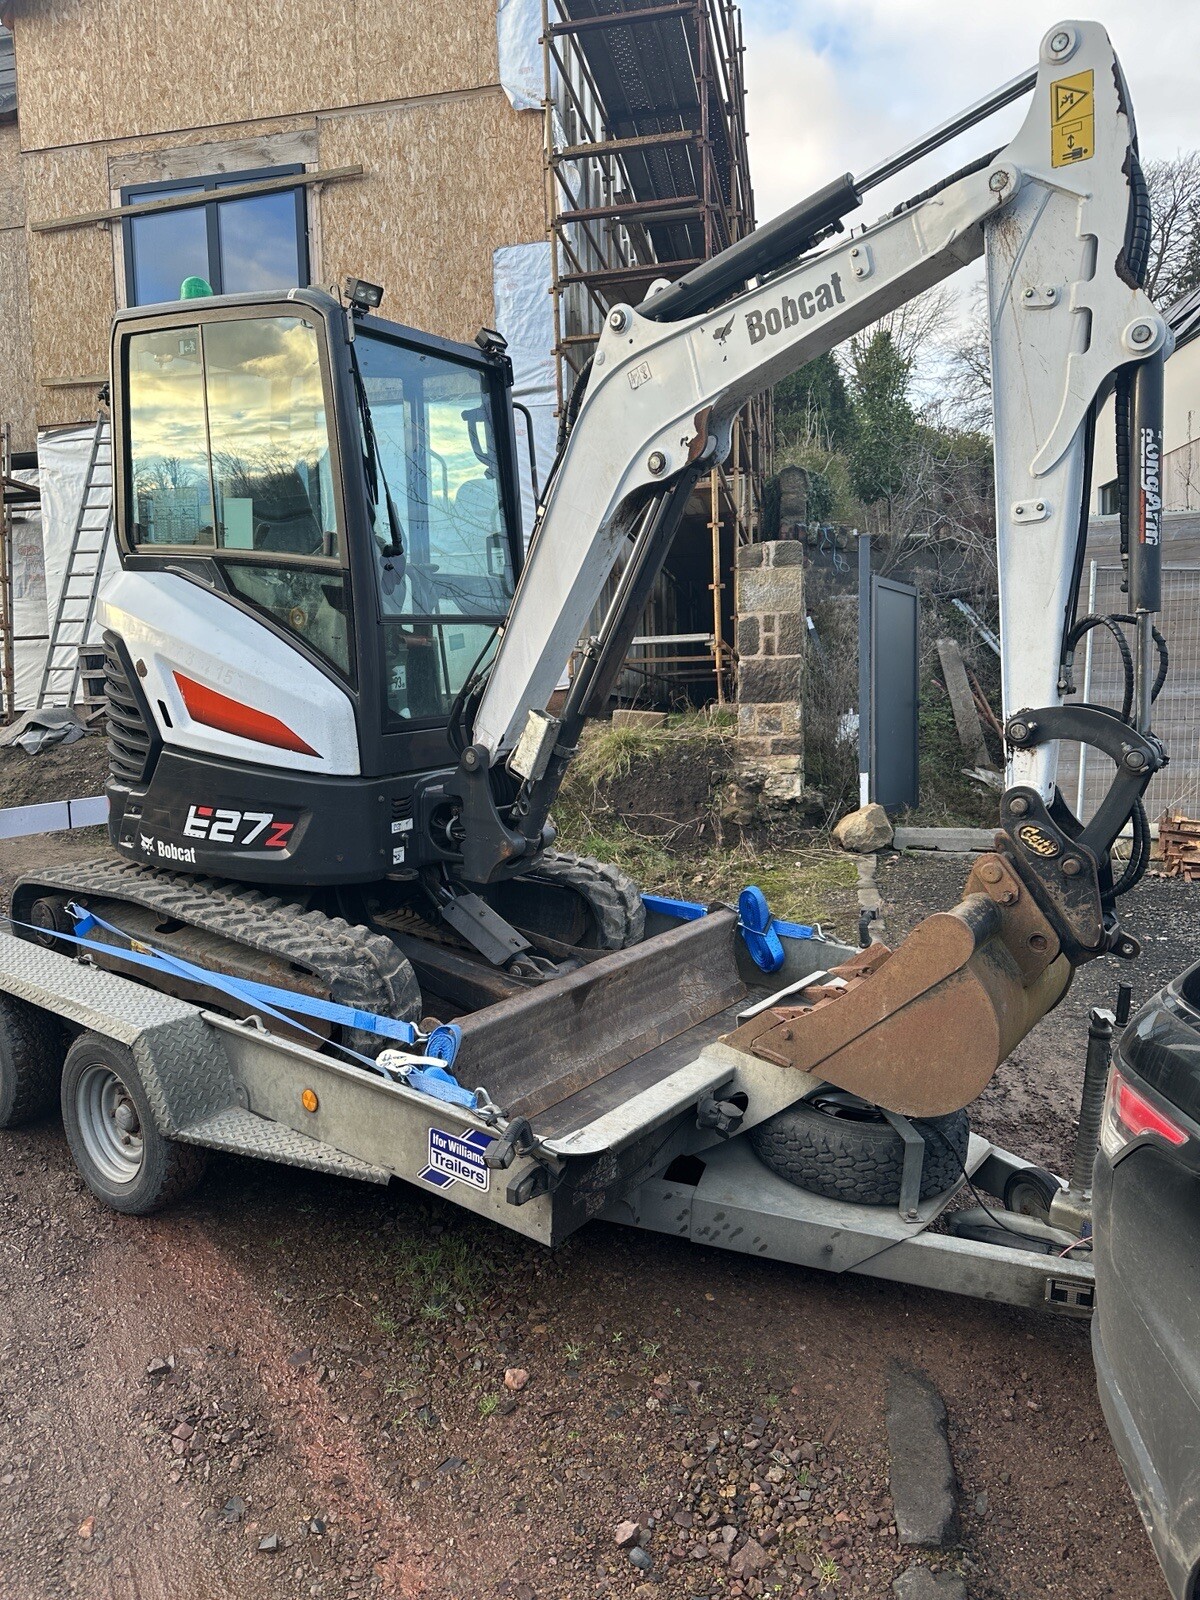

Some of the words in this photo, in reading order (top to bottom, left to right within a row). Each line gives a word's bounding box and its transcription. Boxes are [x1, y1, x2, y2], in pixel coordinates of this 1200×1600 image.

[745, 271, 846, 346] Bobcat
[156, 839, 197, 865] Bobcat
[432, 1132, 447, 1149] Ifor
[448, 1138, 485, 1166] Williams
[432, 1149, 485, 1185] Trailers
